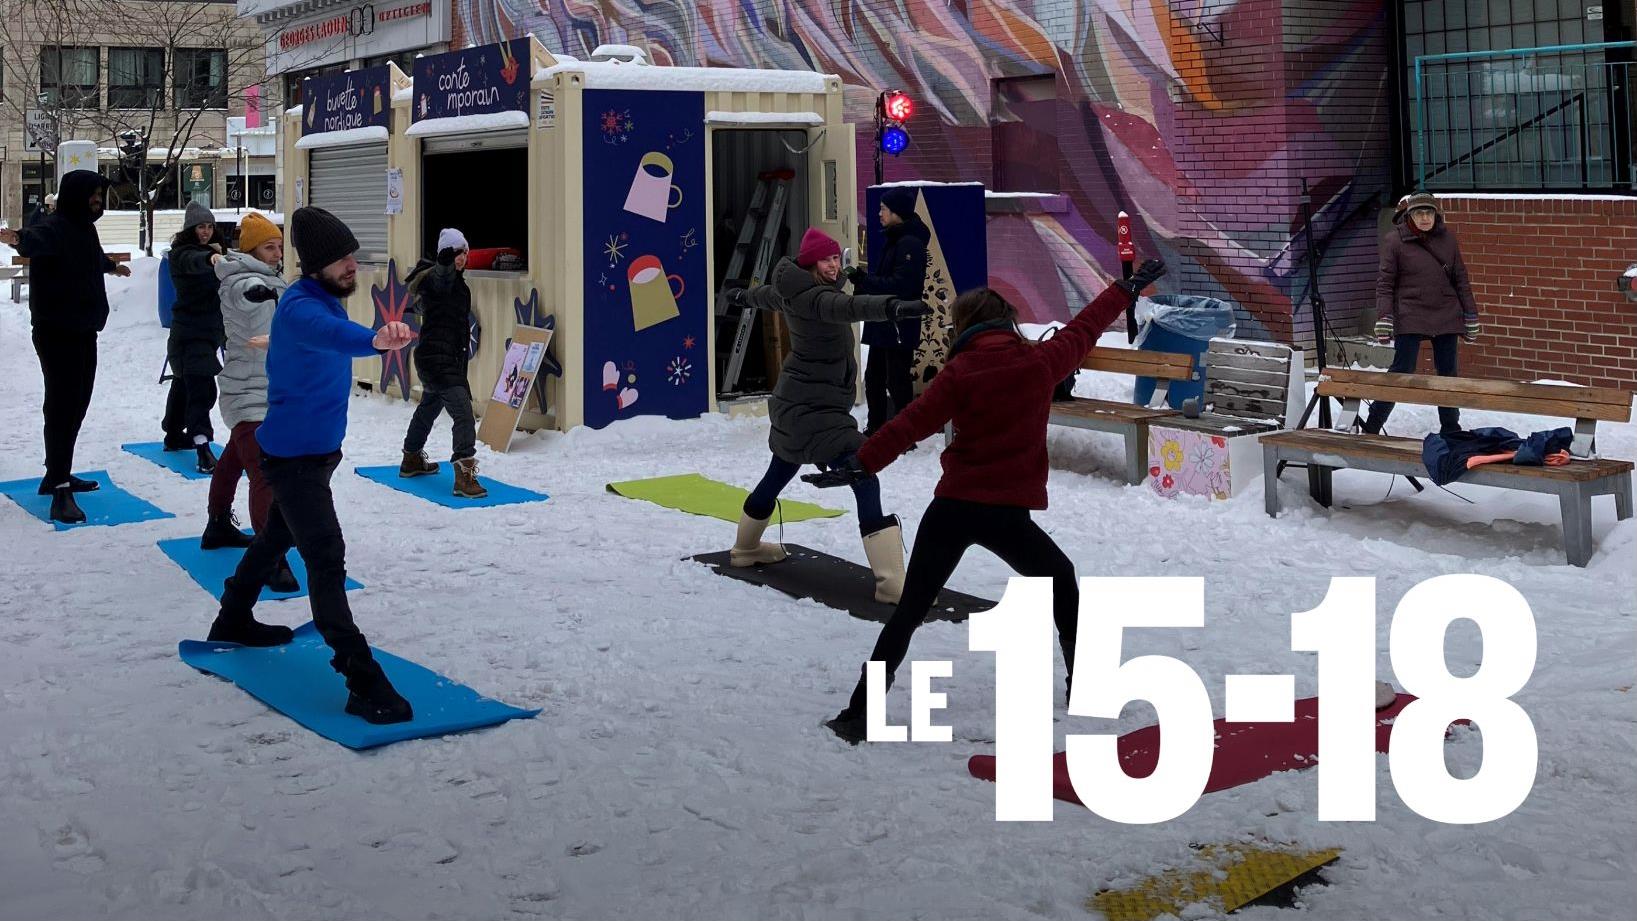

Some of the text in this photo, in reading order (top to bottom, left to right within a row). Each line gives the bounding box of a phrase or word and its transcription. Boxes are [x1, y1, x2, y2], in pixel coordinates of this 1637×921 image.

[438, 56, 470, 91] conte
[326, 75, 358, 112] buvette
[447, 86, 500, 117] mporain
[324, 111, 363, 132] nordique
